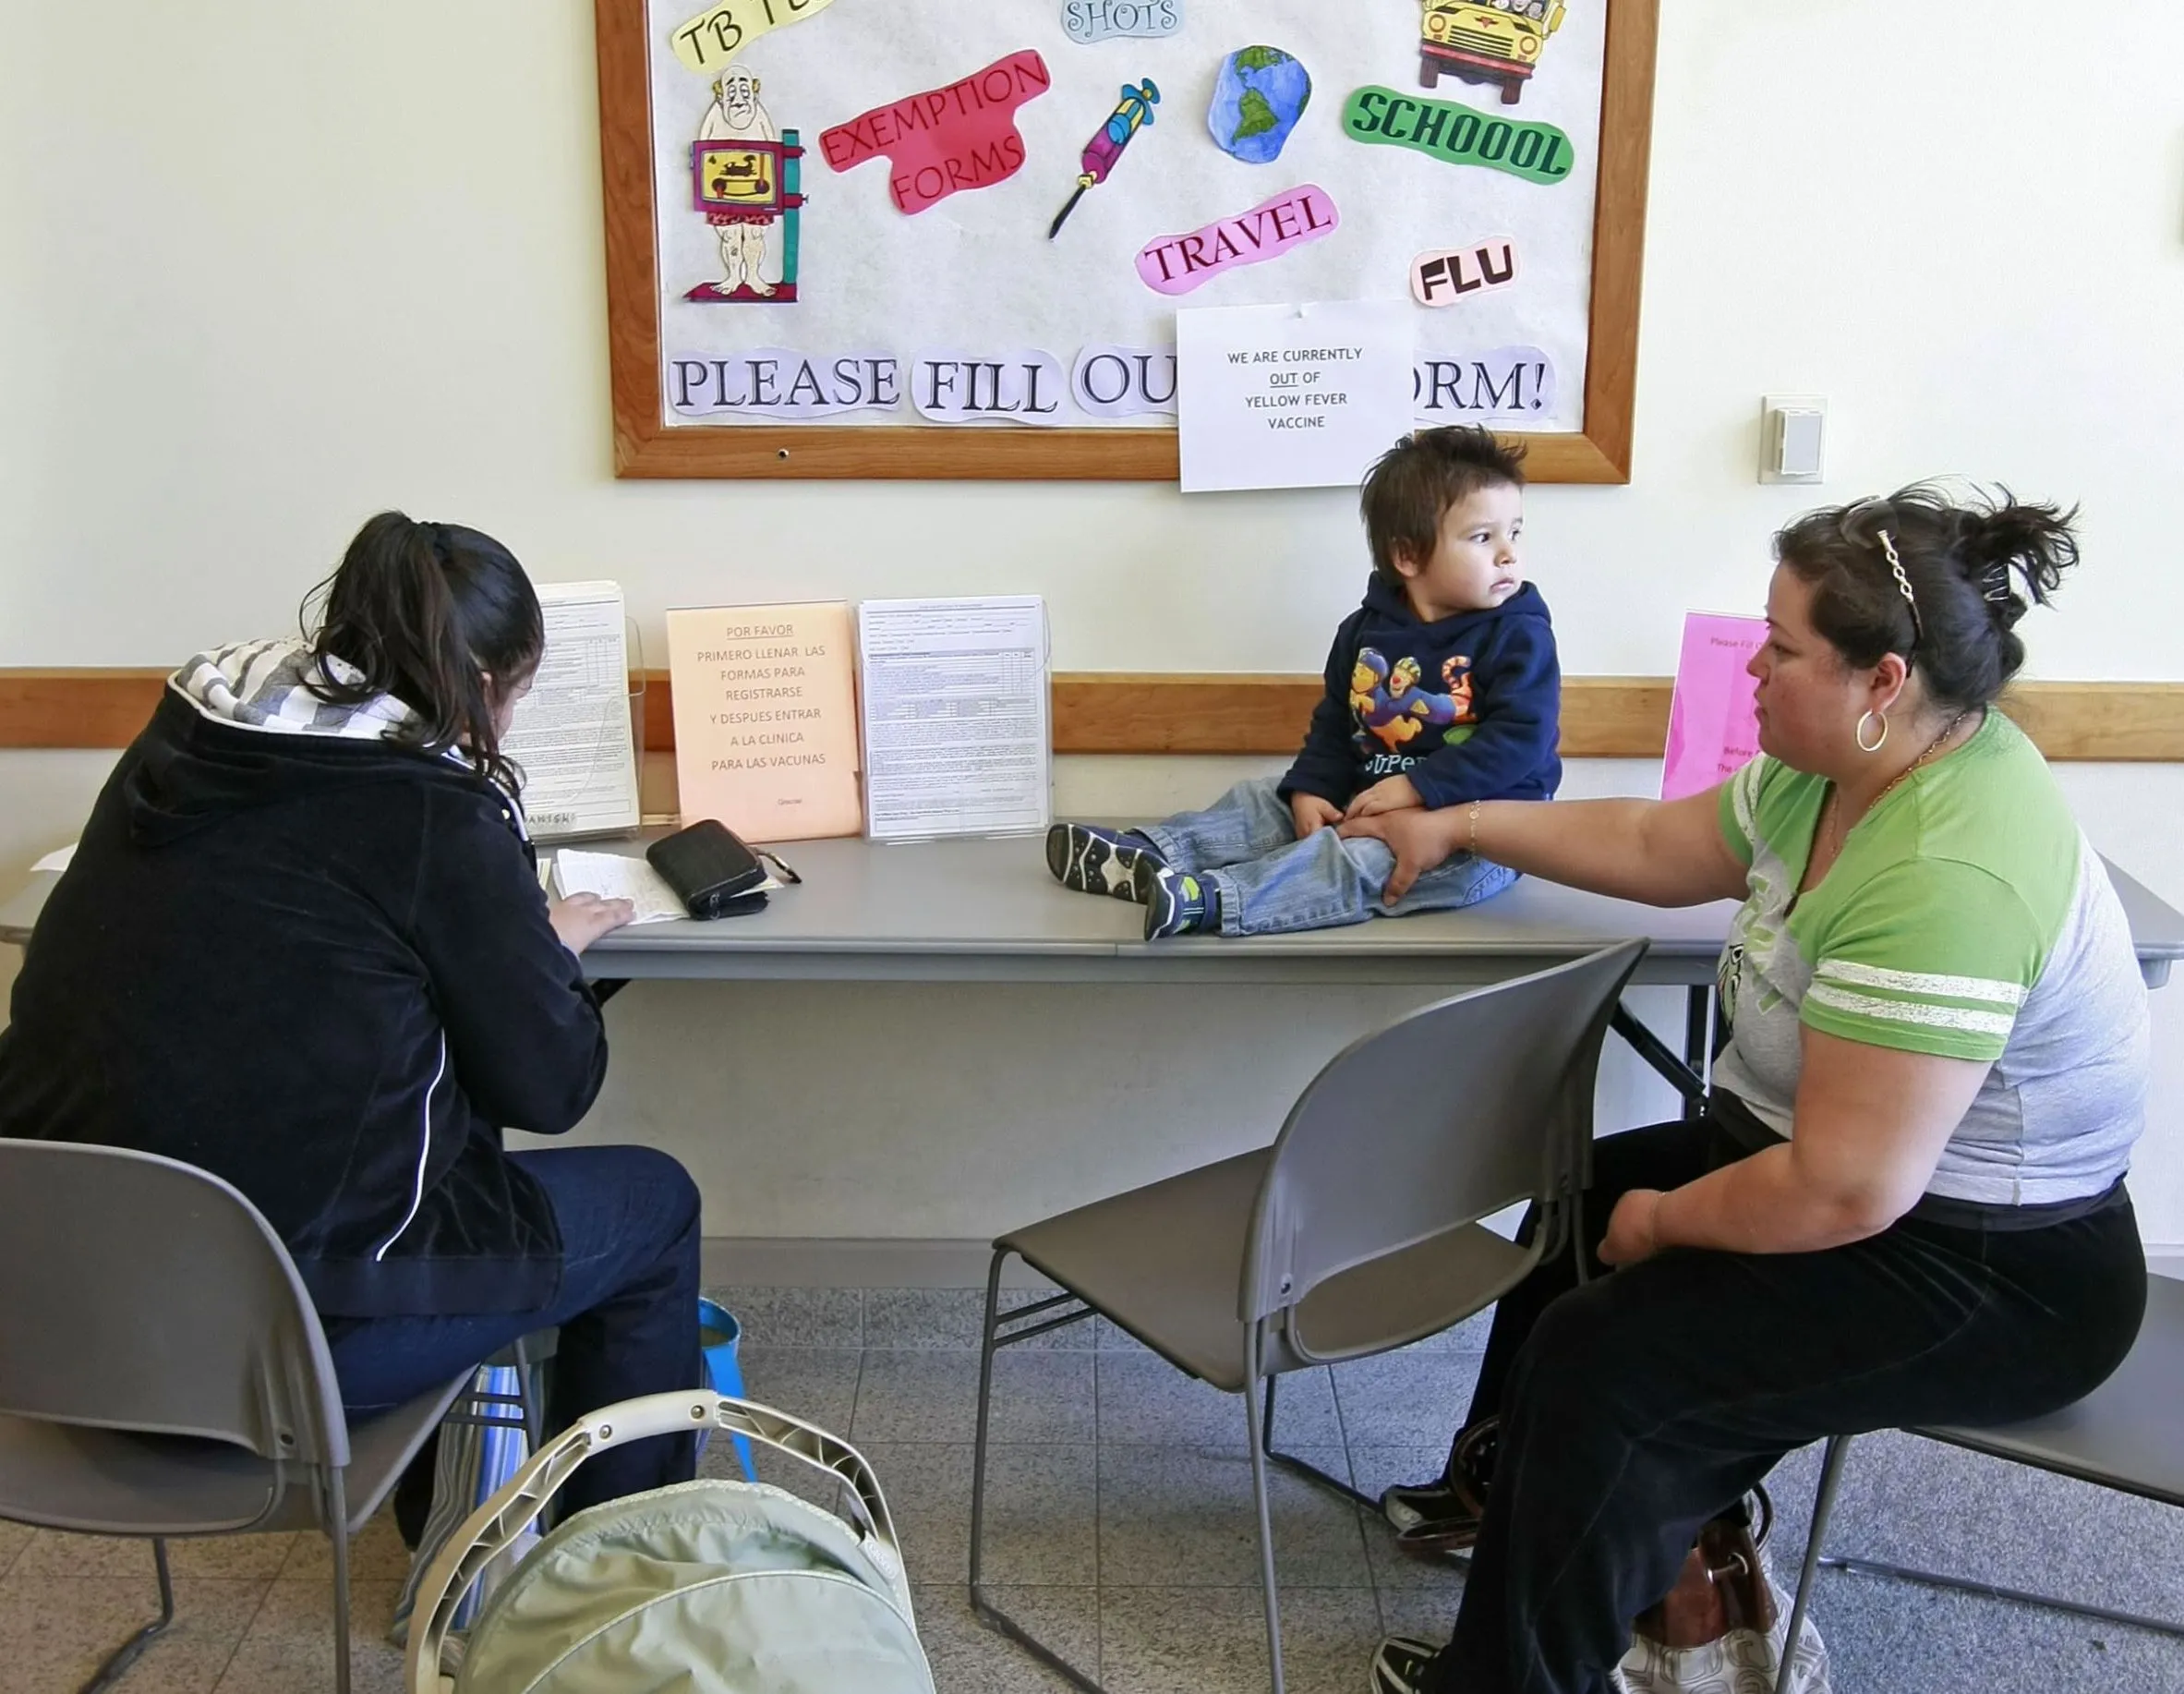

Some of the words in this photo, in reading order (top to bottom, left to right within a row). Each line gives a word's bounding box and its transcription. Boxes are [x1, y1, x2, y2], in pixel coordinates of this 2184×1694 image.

[1068, 0, 1177, 37] SHOTS
[680, 10, 742, 65] TB
[822, 55, 1048, 165] EXEMPTION
[1351, 92, 1567, 175] SCHOOOL
[891, 135, 1024, 209] FORMS
[1144, 196, 1333, 282] TRAVEL
[1419, 245, 1514, 300] FLU
[1227, 353, 1249, 364] WE
[1253, 351, 1279, 363] ARE
[1283, 348, 1363, 362] CURRENTLY
[672, 358, 900, 406] PLEASE
[924, 360, 1058, 413] FILL
[1081, 354, 1176, 404] OU
[1270, 373, 1298, 385] OUT
[1303, 372, 1321, 383] OF
[1246, 395, 1300, 407] YELLOW
[1305, 393, 1347, 405] FEVER
[1268, 417, 1325, 429] VACCINE
[727, 627, 751, 637] POR
[754, 624, 794, 636] FAVOR
[697, 649, 753, 662] PRIMERO
[755, 647, 798, 659] LLENAR
[805, 646, 826, 657] LAS
[720, 668, 771, 681] FORMAS
[774, 667, 805, 678] PARA
[726, 686, 802, 701] REGISTRARSE
[710, 714, 717, 724] Y
[720, 710, 772, 724] DESPUES
[775, 708, 821, 721] ENTRAR
[730, 736, 739, 746] A
[742, 735, 756, 745] LA
[711, 758, 743, 770] PARA
[746, 756, 767, 768] LAS
[769, 753, 826, 767] VACUNAS
[1365, 754, 1427, 774] UPe
